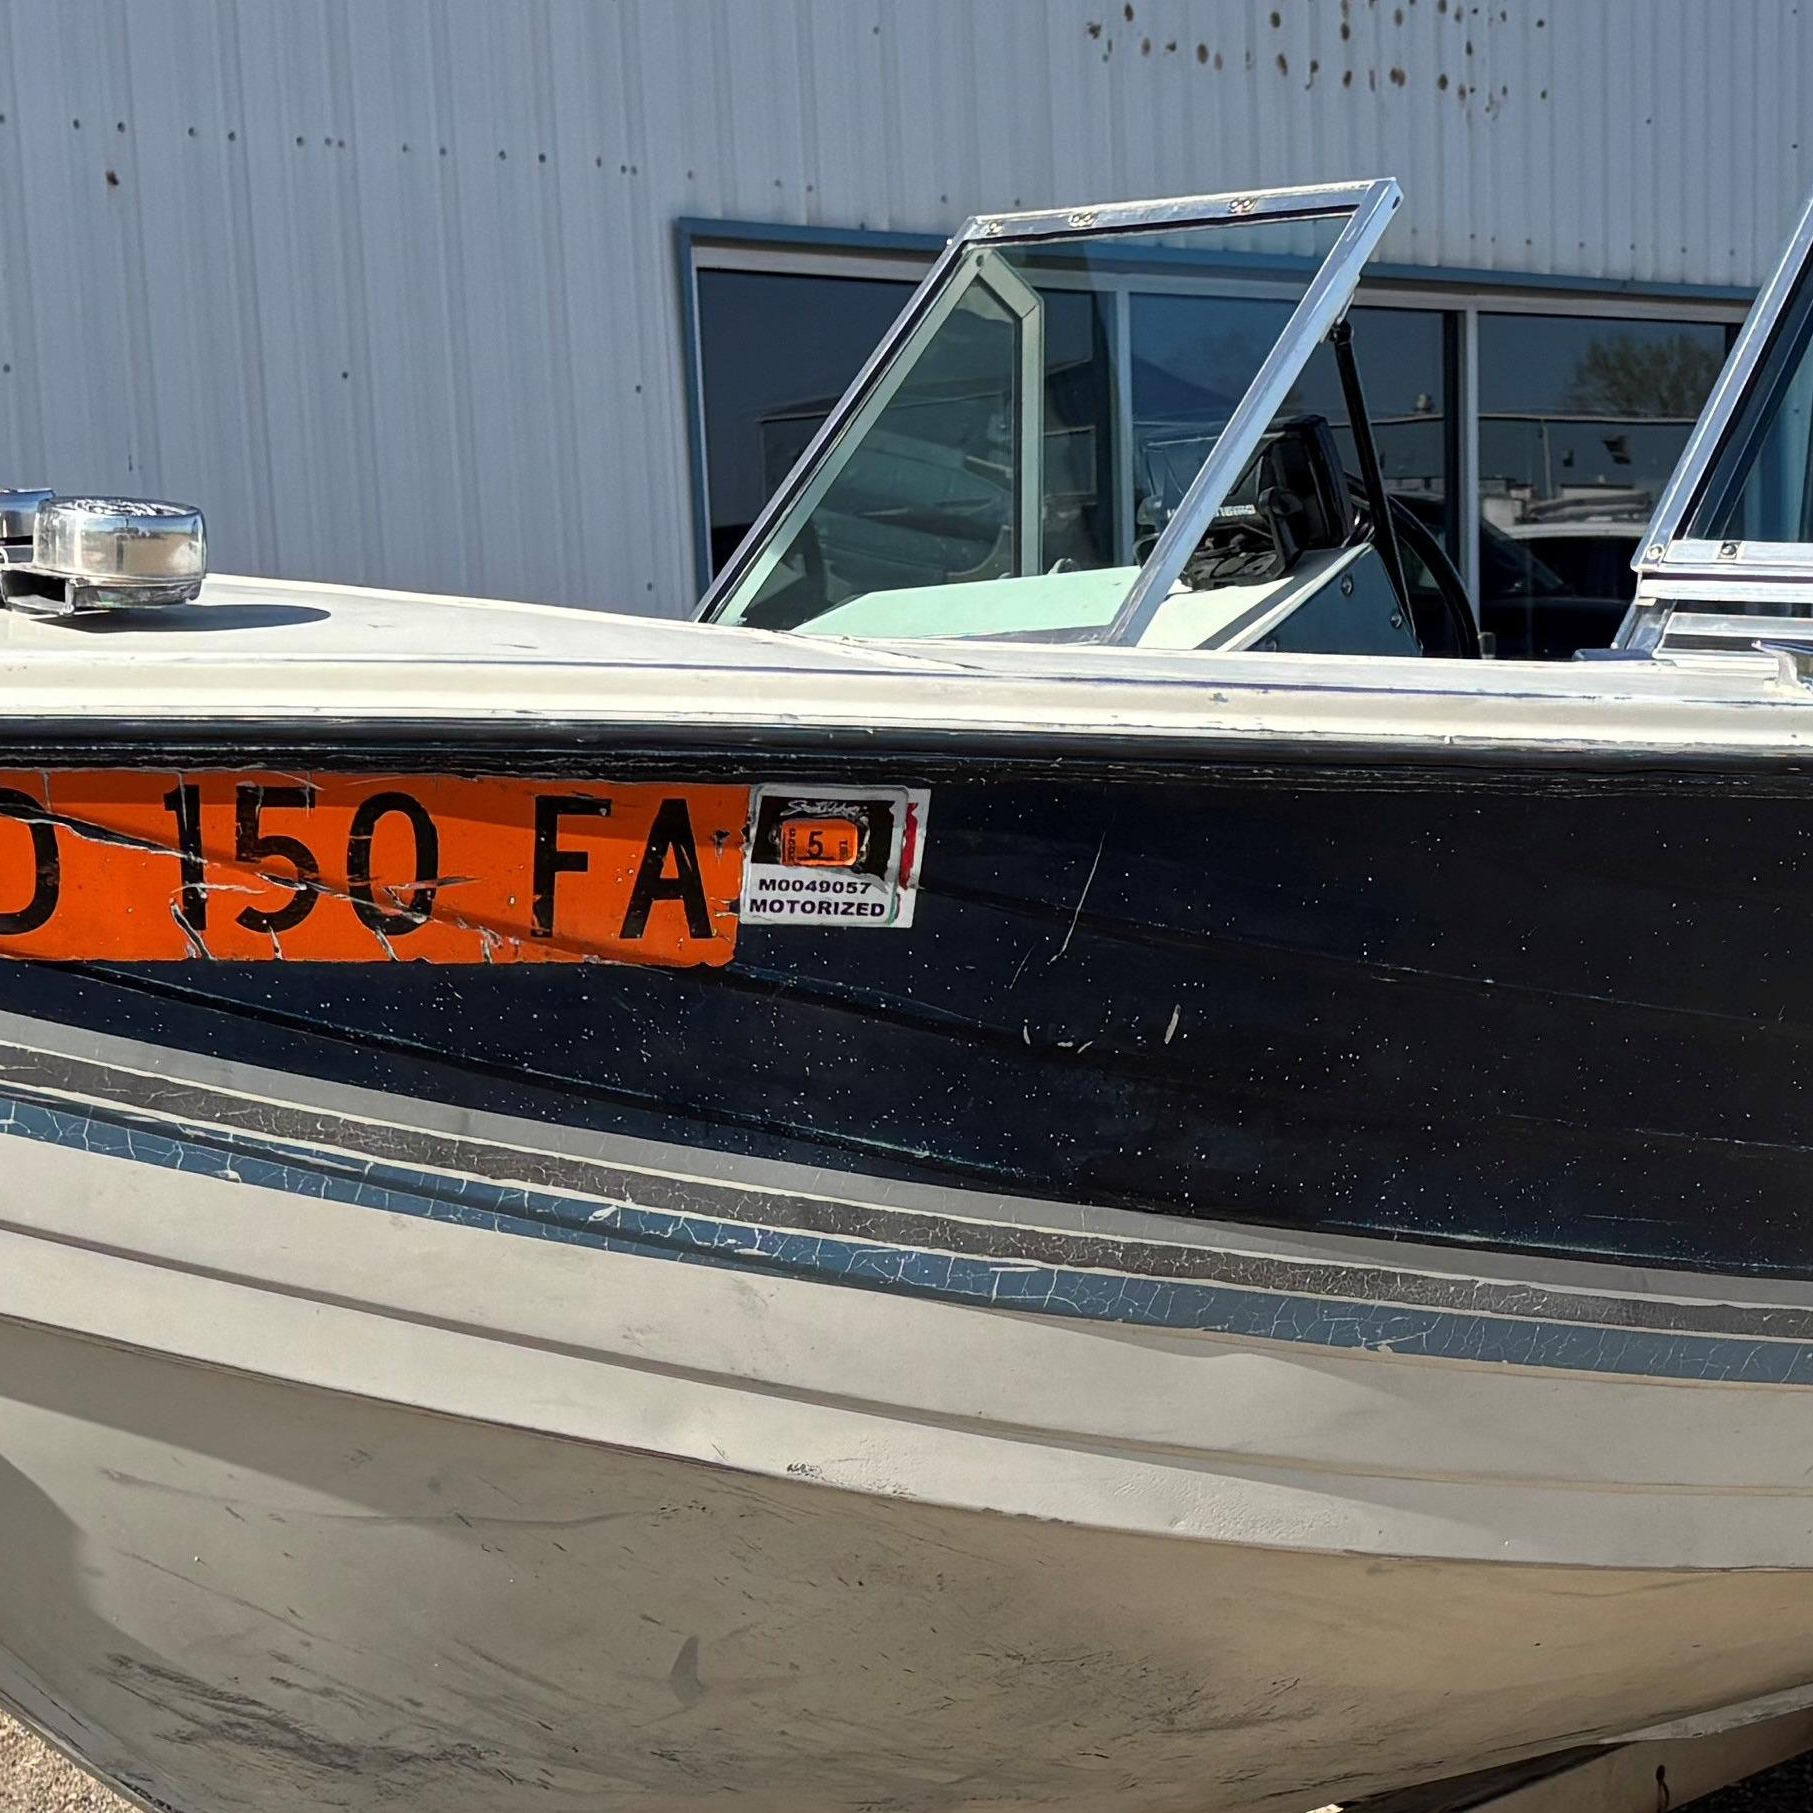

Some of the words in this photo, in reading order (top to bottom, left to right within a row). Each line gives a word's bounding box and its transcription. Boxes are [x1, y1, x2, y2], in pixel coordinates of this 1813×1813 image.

[806, 831, 825, 858] 5
[162, 783, 440, 937] 150
[532, 795, 714, 940] FA
[750, 898, 885, 917] MOTORIZED
